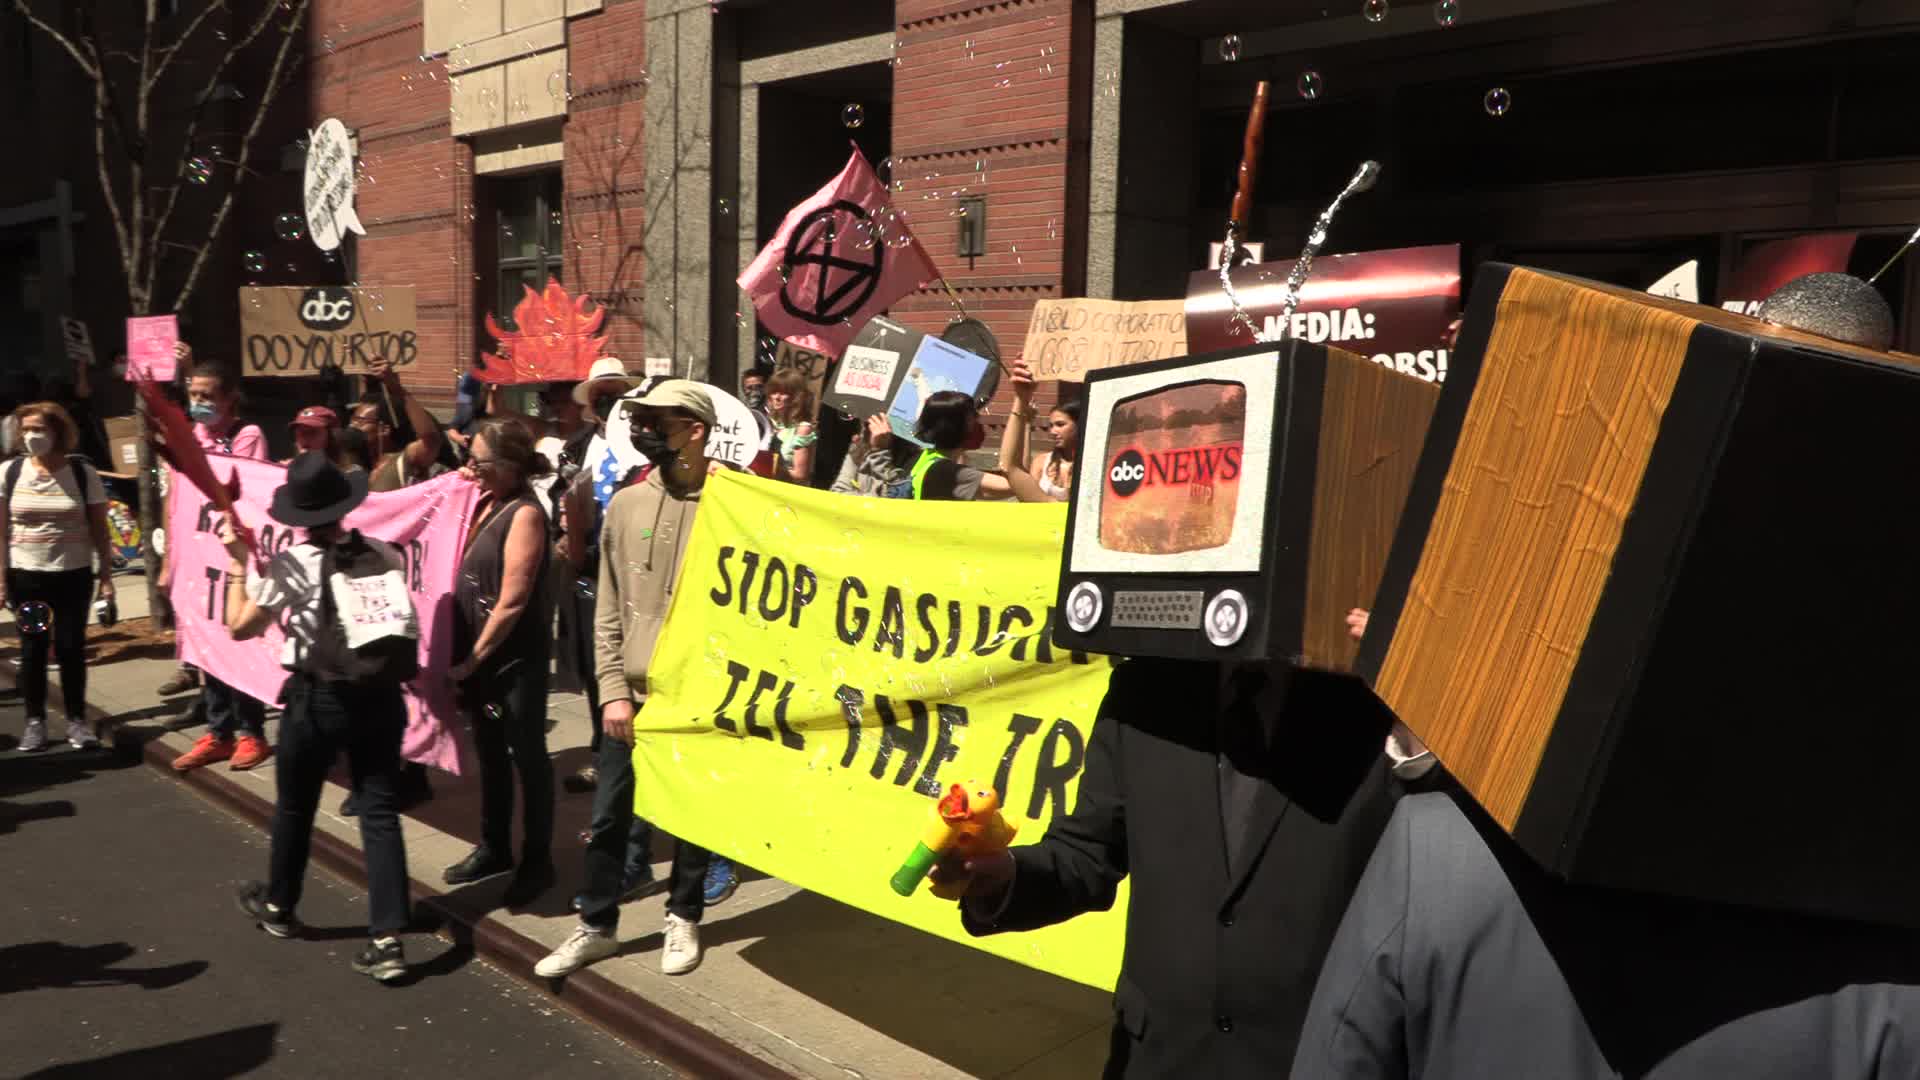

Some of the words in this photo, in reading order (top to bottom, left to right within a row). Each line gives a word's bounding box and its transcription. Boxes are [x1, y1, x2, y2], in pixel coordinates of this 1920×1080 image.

[302, 290, 352, 321] abc
[1264, 306, 1376, 344] MEDIA:
[248, 334, 292, 371] DO
[293, 331, 369, 371] YOUR
[368, 330, 417, 366] JOB
[708, 440, 745, 461] ATE
[1110, 460, 1145, 482] abc
[1145, 446, 1242, 486] NEWS
[709, 546, 818, 628] STOP
[834, 683, 969, 799] THE
[992, 713, 1086, 821] TR
